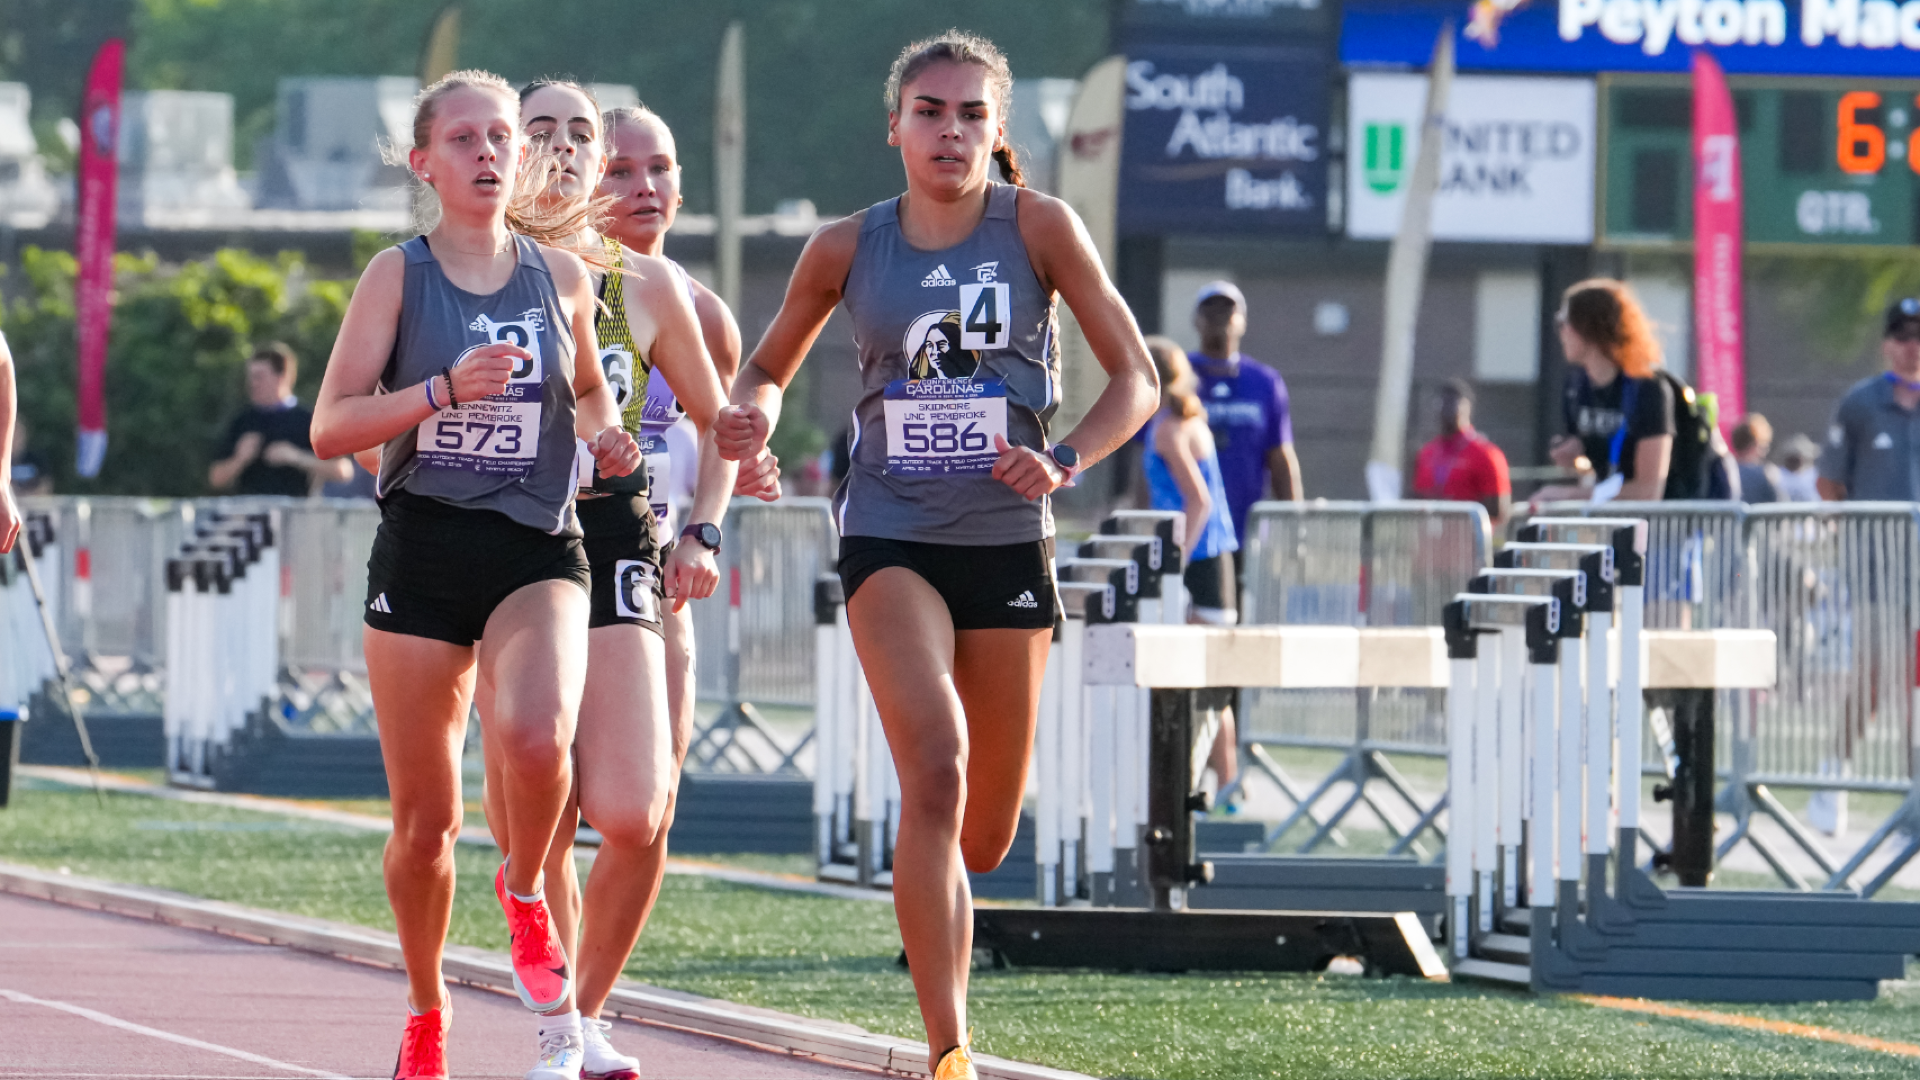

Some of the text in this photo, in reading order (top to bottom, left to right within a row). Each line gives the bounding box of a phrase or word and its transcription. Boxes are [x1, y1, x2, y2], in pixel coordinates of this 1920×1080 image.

[1558, 0, 1786, 55] Peyton
[1126, 61, 1243, 110] South
[1165, 108, 1318, 160] Atlantic
[1440, 164, 1532, 197] ANK
[921, 279, 956, 287] adidas
[966, 287, 1002, 344] 4
[906, 384, 984, 396] CAROLINAS
[468, 413, 523, 422] PEMBROKE
[903, 410, 987, 421] UNC PEMBROKE
[918, 402, 971, 412] SKIDMORE
[435, 420, 523, 454] 573
[903, 422, 987, 452] 586
[1007, 600, 1038, 609] adidas
